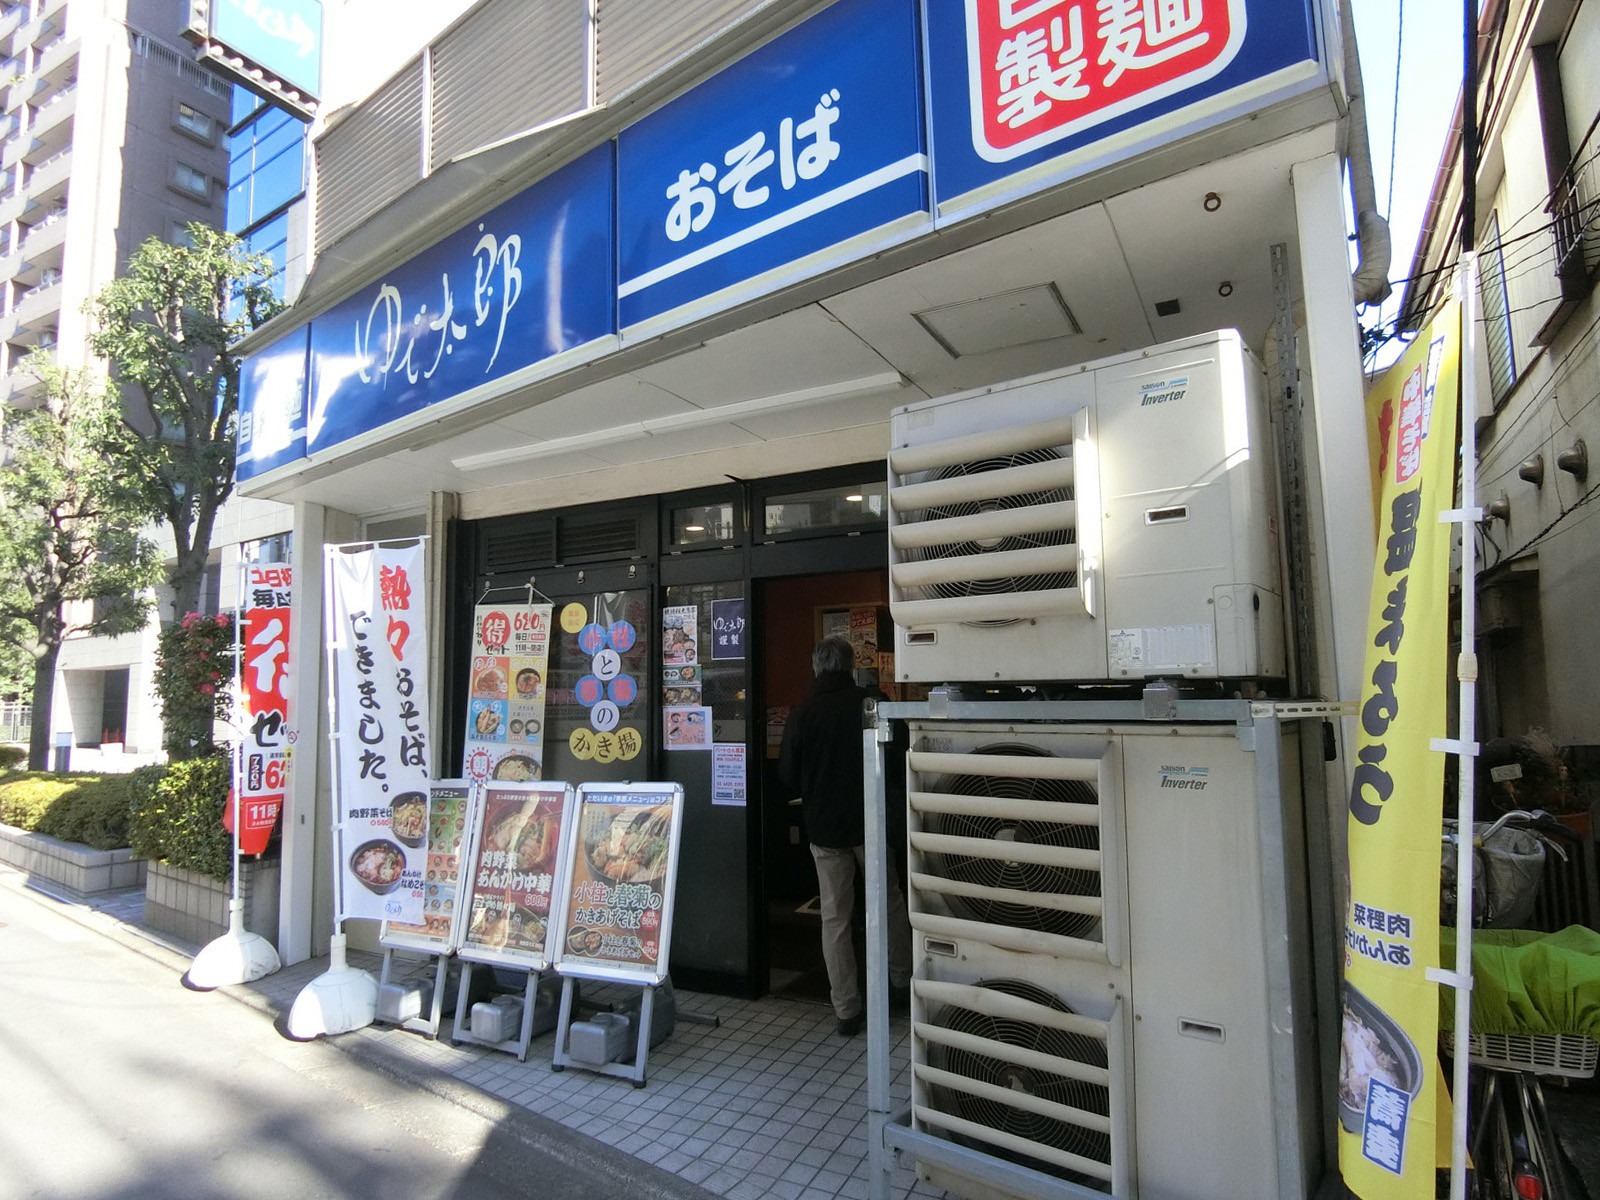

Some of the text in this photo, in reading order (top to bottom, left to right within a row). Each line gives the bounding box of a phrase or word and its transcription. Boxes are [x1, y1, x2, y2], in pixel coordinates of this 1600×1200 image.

[664, 89, 841, 242] おそば
[1141, 390, 1187, 407] Inverter
[600, 655, 613, 675] と
[597, 708, 613, 725] の
[573, 731, 637, 758] かき揚
[1161, 775, 1208, 790] Inverter
[575, 908, 643, 929] かきあげそば
